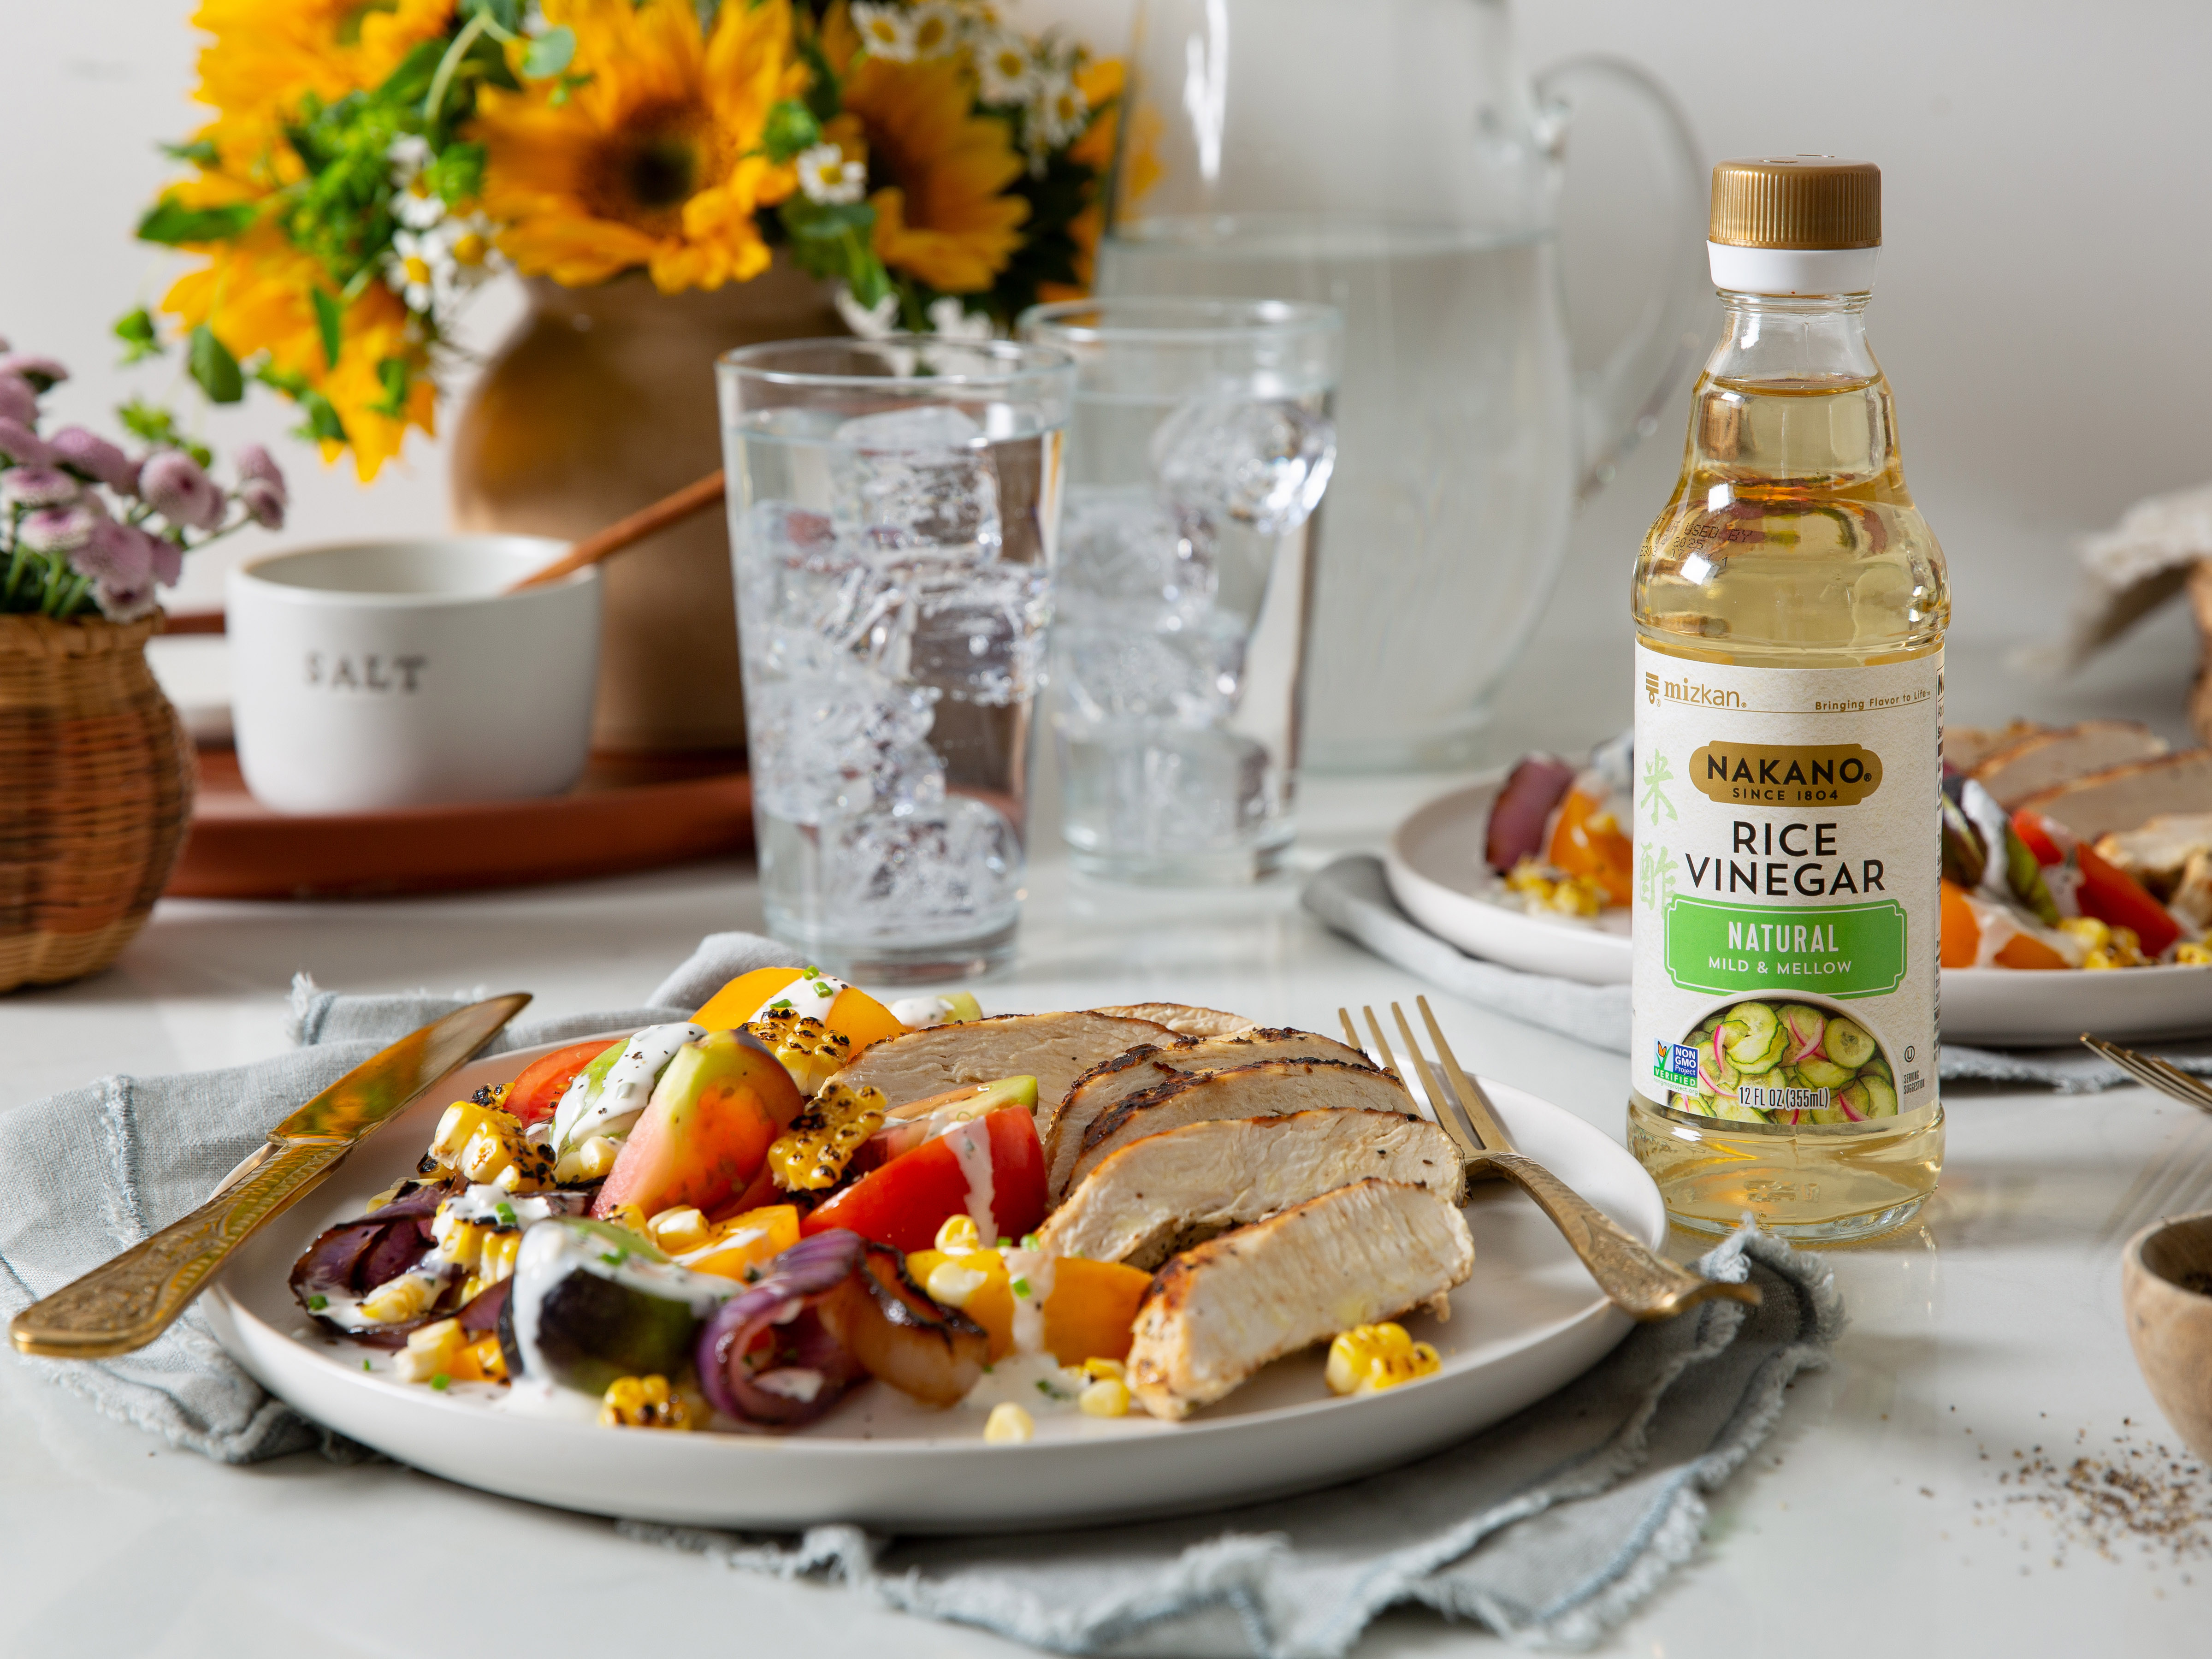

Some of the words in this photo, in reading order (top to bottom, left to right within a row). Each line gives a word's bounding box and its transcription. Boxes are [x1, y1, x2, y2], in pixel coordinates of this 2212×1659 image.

[1684, 523, 1720, 539] USED
[1727, 528, 1753, 542] BY
[1673, 537, 1705, 550] 2025
[305, 653, 427, 694] SALT
[1816, 700, 1864, 711] Bringing
[1870, 697, 1899, 707] Flavor
[1733, 788, 1785, 800] SINCE
[1798, 789, 1838, 801] 1804
[1733, 821, 1837, 857] RICE
[1685, 853, 1886, 897] VINEGAR
[1729, 921, 1839, 953] NATURAL
[1709, 956, 1749, 972] MILD
[1757, 961, 1768, 974] &
[1777, 960, 1851, 974] MELLOW
[1675, 1047, 1696, 1060] NON
[1675, 1056, 1696, 1068] GMO
[1655, 1067, 1696, 1086] VERIFIED
[1675, 1065, 1696, 1076] Project
[1904, 1070, 1919, 1084] SERVING
[1653, 1078, 1698, 1096] nongmoproject.org
[1904, 1078, 1925, 1094] SUGGESTION
[1740, 1087, 1751, 1104] 12
[1755, 1088, 1765, 1106] FL
[1769, 1089, 1782, 1107] OZ
[1786, 1088, 1828, 1108] (355mL)
